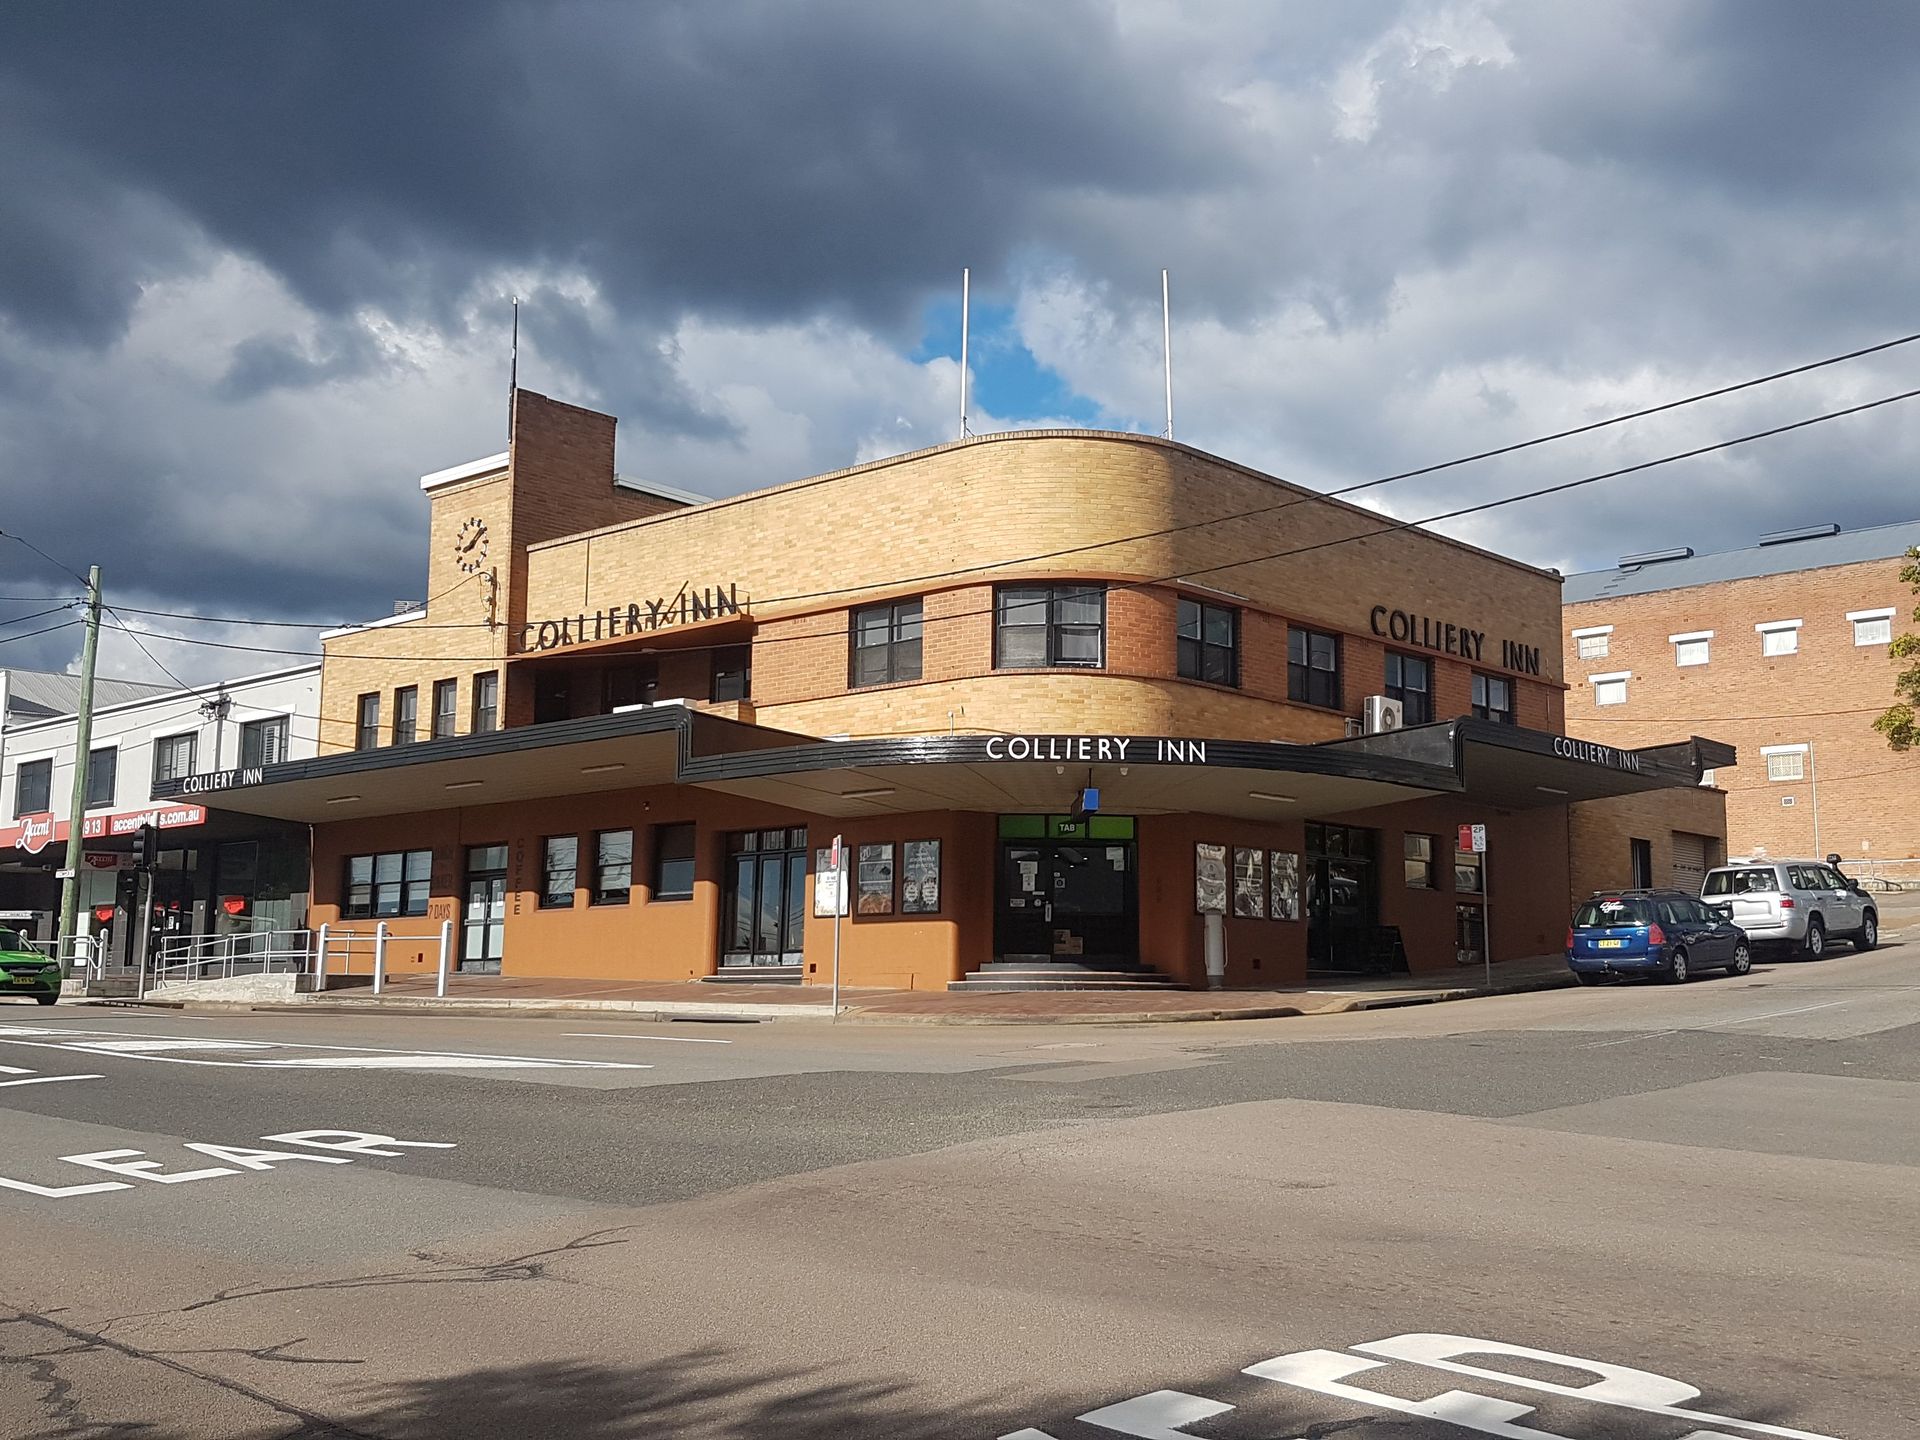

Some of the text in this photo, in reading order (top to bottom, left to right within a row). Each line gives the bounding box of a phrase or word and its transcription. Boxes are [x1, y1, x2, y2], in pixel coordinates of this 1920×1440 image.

[519, 583, 736, 653] COLLIERY INN
[1370, 605, 1540, 676] COLLIERY INN
[986, 737, 1206, 763] COLLIERY INN
[1553, 737, 1639, 771] COLLIERY INN
[183, 767, 263, 793] COLLIERY INN
[1060, 824, 1075, 832] TAB
[513, 838, 525, 915] COFFEE
[428, 903, 451, 919] 7 DAYS
